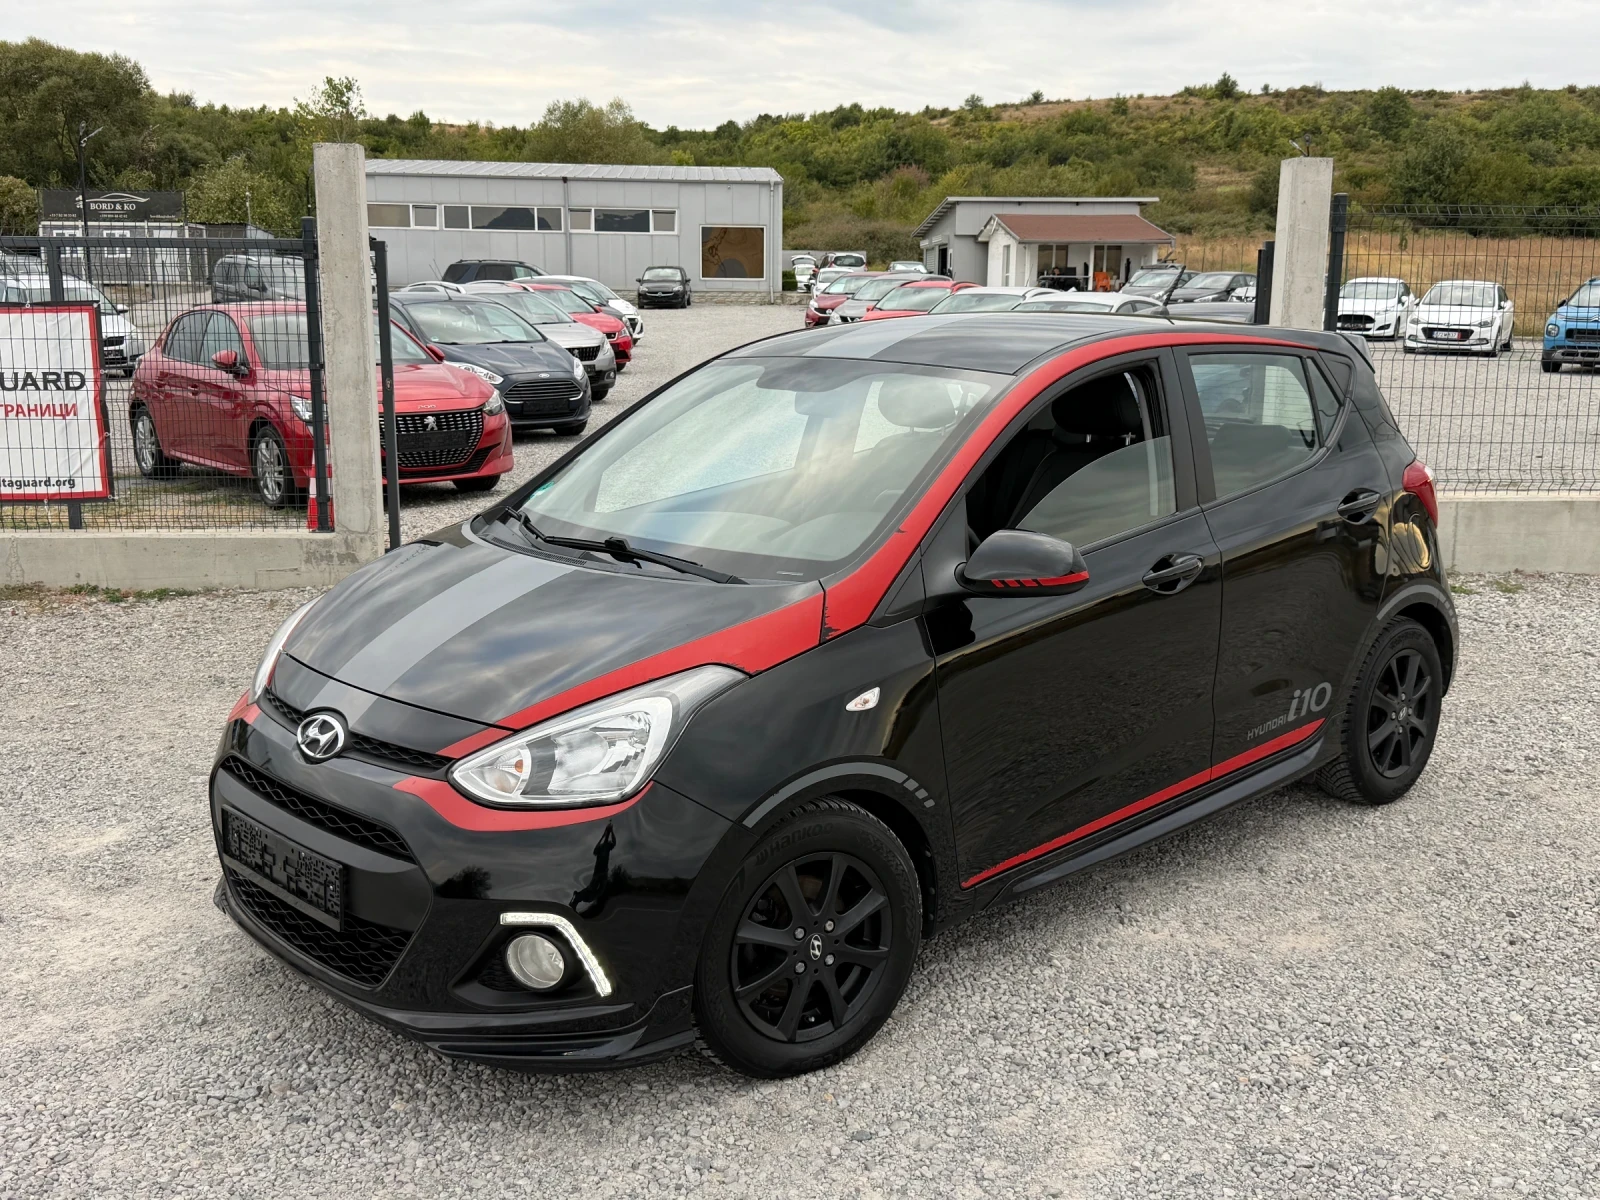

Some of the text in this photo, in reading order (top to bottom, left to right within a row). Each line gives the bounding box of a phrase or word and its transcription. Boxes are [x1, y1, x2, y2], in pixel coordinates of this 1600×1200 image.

[123, 203, 136, 211] KO
[1247, 682, 1333, 741] HYUNDAI i10
